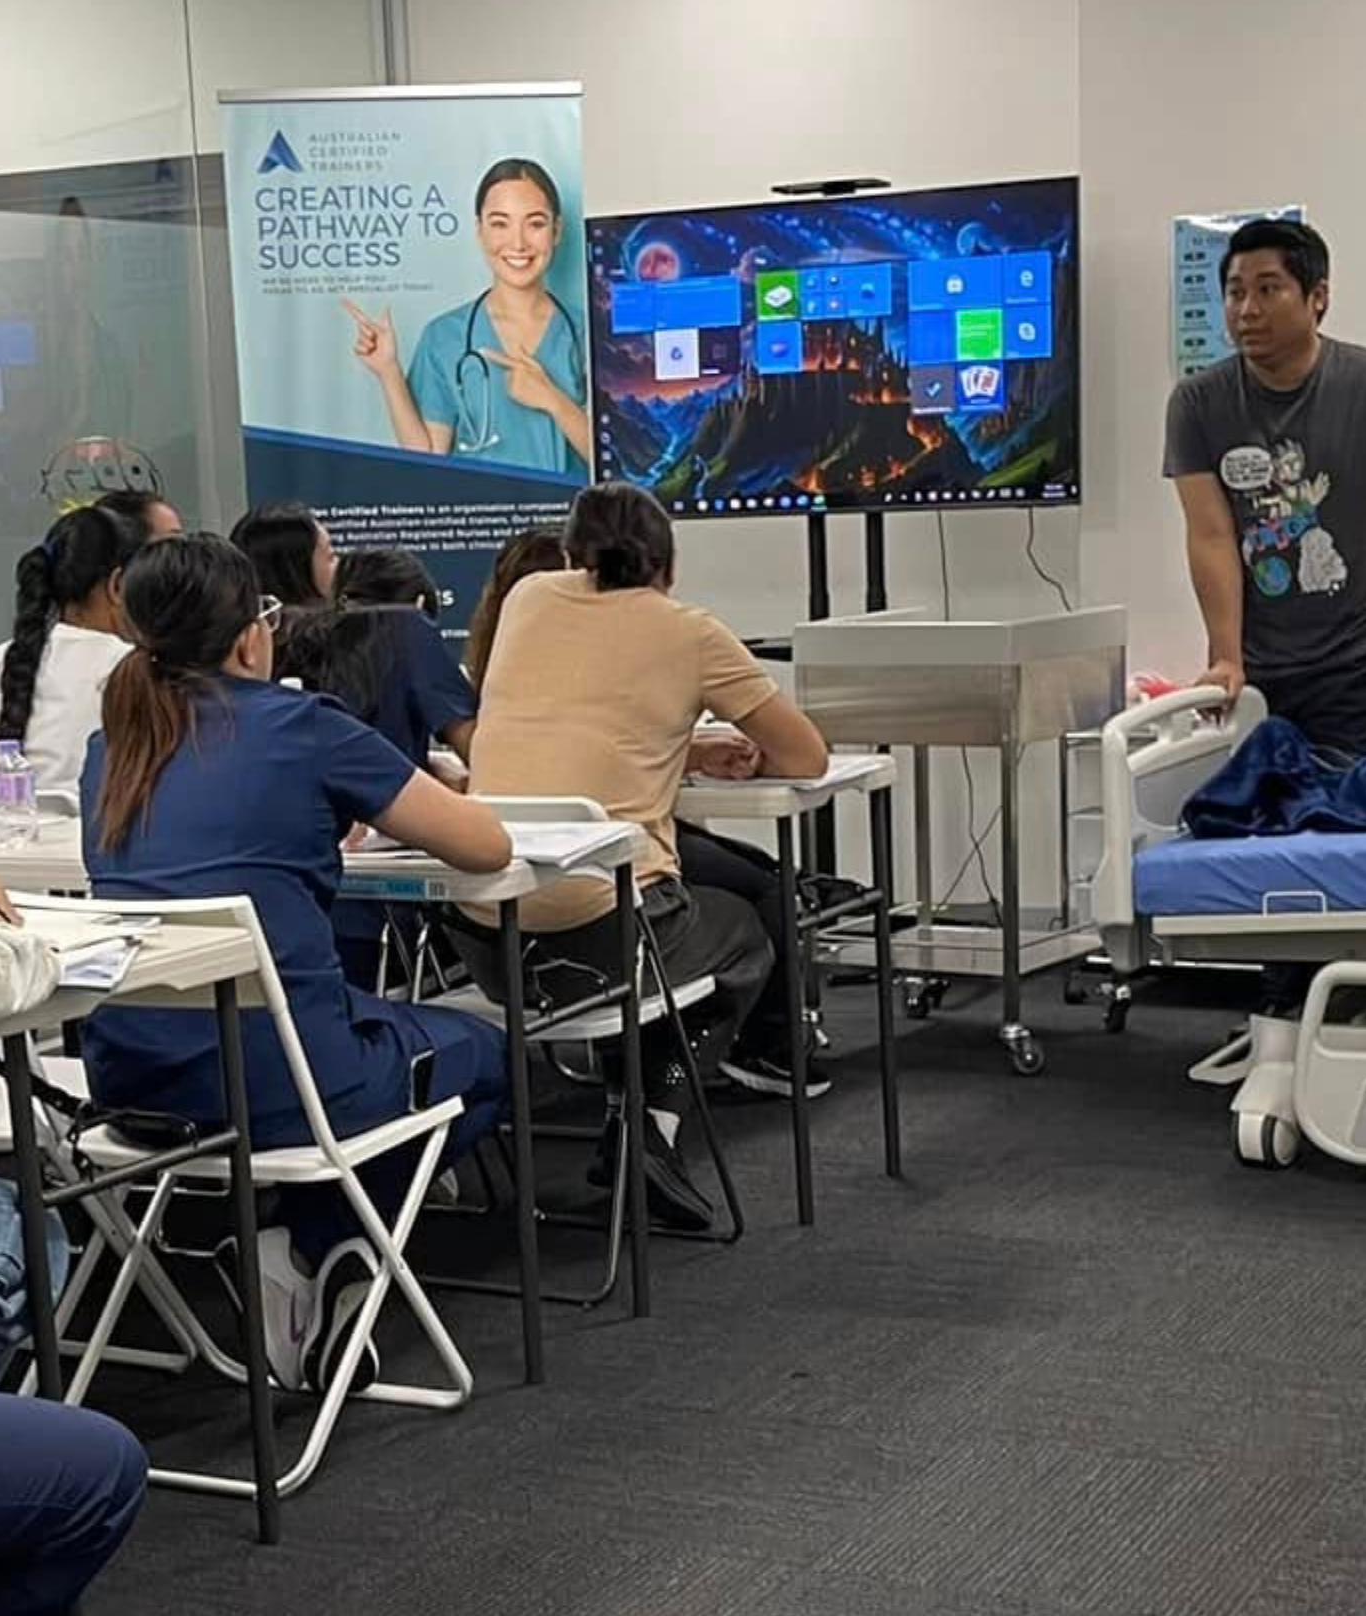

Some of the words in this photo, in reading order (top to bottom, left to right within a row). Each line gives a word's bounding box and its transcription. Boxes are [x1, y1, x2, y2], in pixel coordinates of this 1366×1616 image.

[308, 132, 402, 144] AUSTRALIAN
[308, 146, 389, 158] CERTIFIED
[309, 160, 384, 172] TRAINERS
[254, 183, 413, 212] CREATING
[423, 183, 446, 208] A
[258, 212, 410, 241] PATHWAY
[417, 211, 460, 237] TO
[258, 242, 401, 270] SUCCESS
